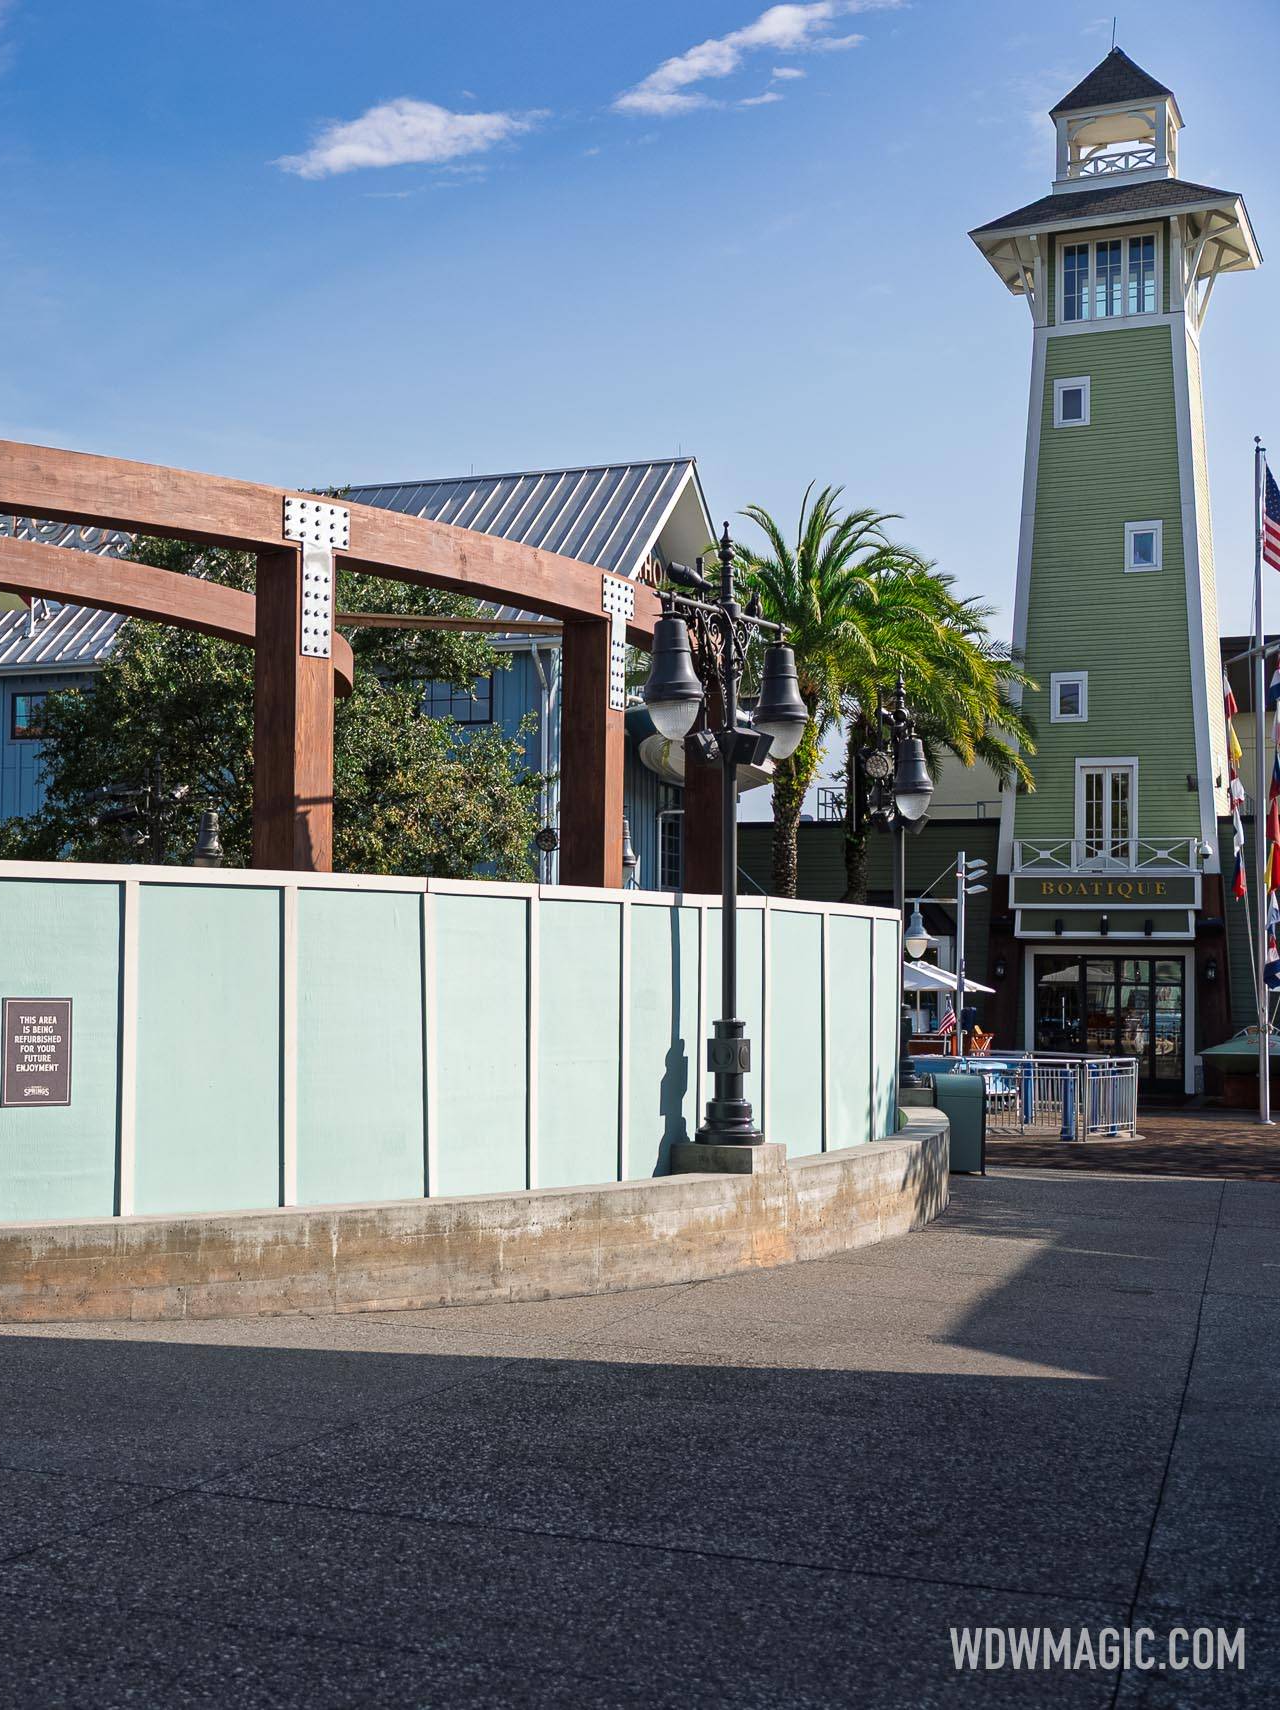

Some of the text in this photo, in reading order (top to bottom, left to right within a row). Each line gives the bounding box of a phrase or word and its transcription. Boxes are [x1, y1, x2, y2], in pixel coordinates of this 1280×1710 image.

[1041, 882, 1166, 898] BOATIQUE
[20, 1016, 57, 1025] THIS AREA
[23, 1025, 54, 1034] IS BEING
[14, 1035, 61, 1044] REFURBISHED
[20, 1044, 56, 1053] FOR YOUR
[24, 1054, 51, 1063] FUTURE
[16, 1063, 59, 1072] ENJOYMENT
[23, 1087, 49, 1096] SPRINGS
